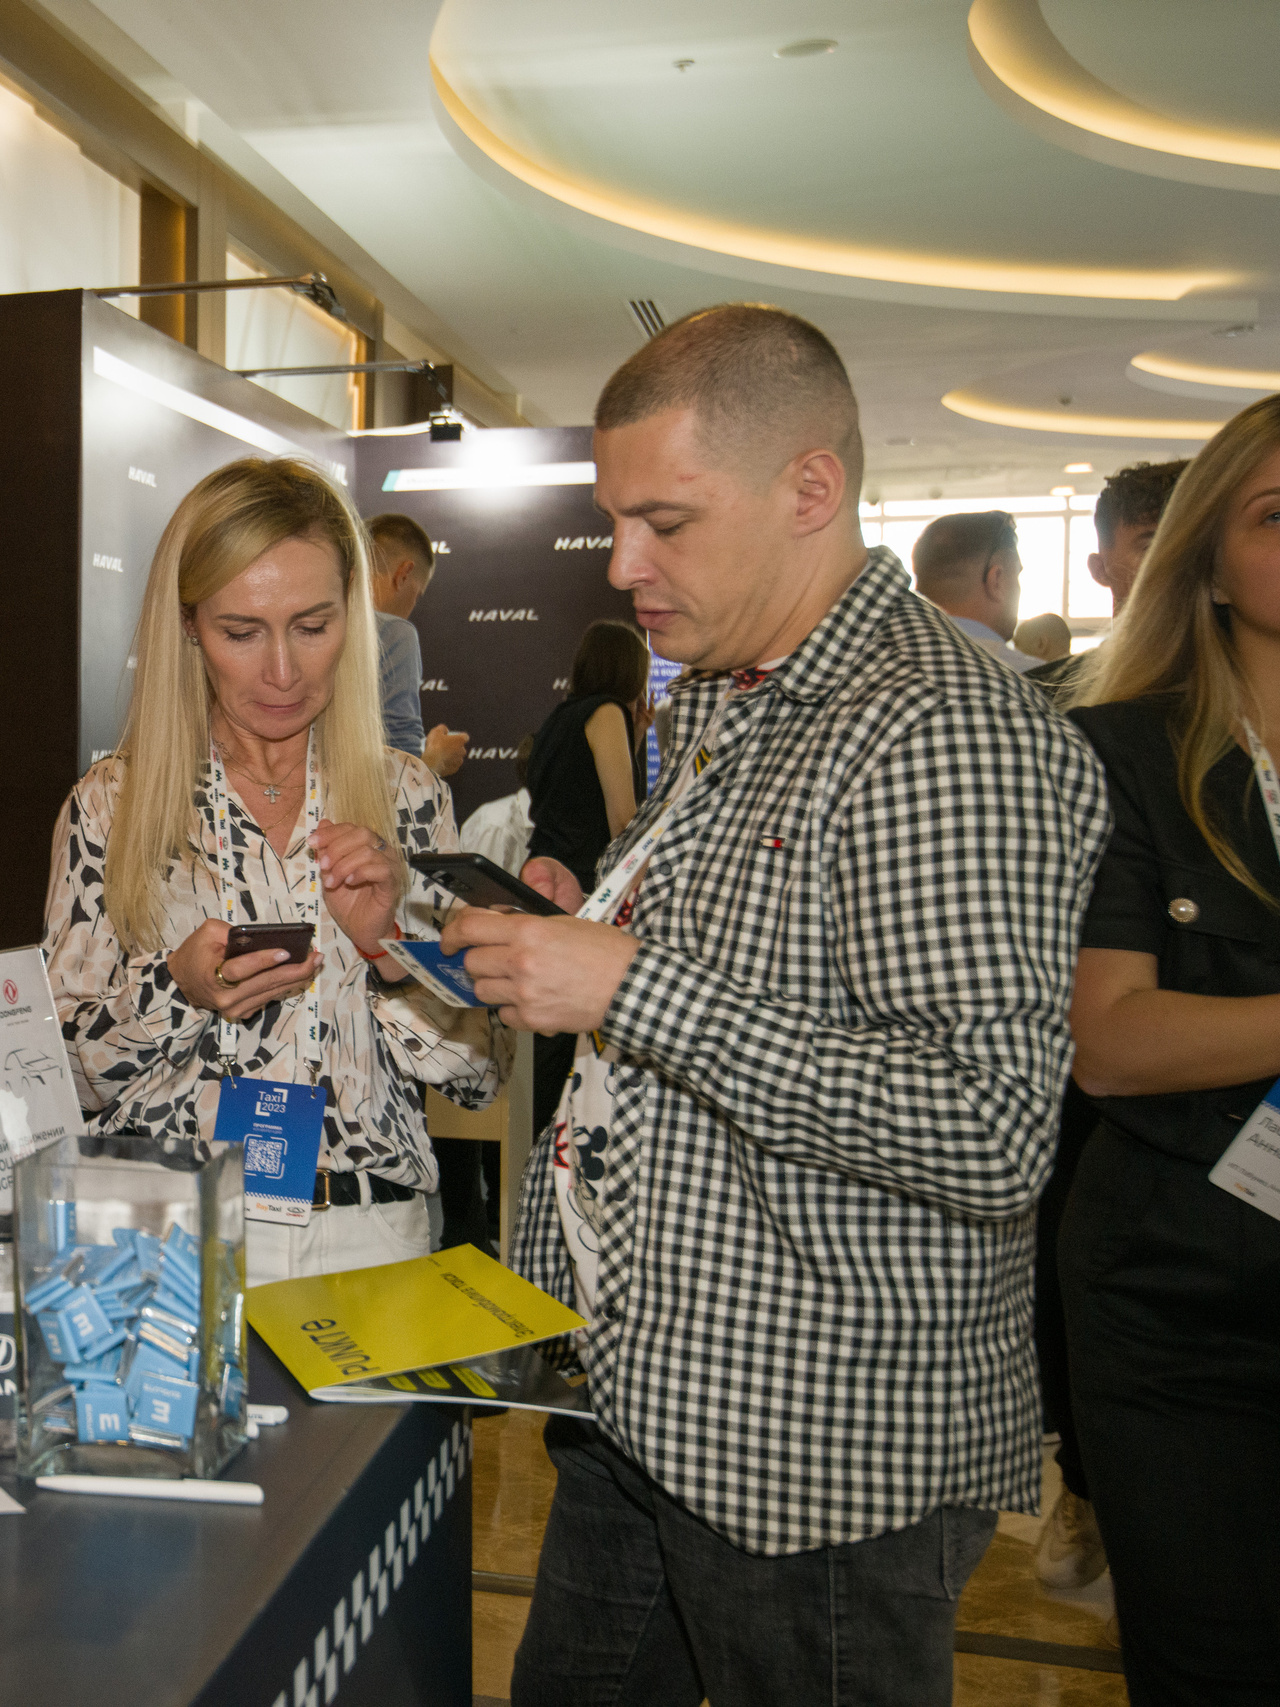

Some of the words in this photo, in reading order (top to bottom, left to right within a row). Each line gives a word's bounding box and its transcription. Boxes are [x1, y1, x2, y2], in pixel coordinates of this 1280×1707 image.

[127, 466, 157, 488] HAVAL
[554, 536, 613, 550] HAVA
[92, 553, 123, 573] HAVAL
[468, 608, 539, 622] HAVAL
[468, 747, 519, 760] HAVA
[258, 1090, 282, 1103] Taxi
[261, 1102, 286, 1113] 2023
[256, 1202, 282, 1212] RayTaxi
